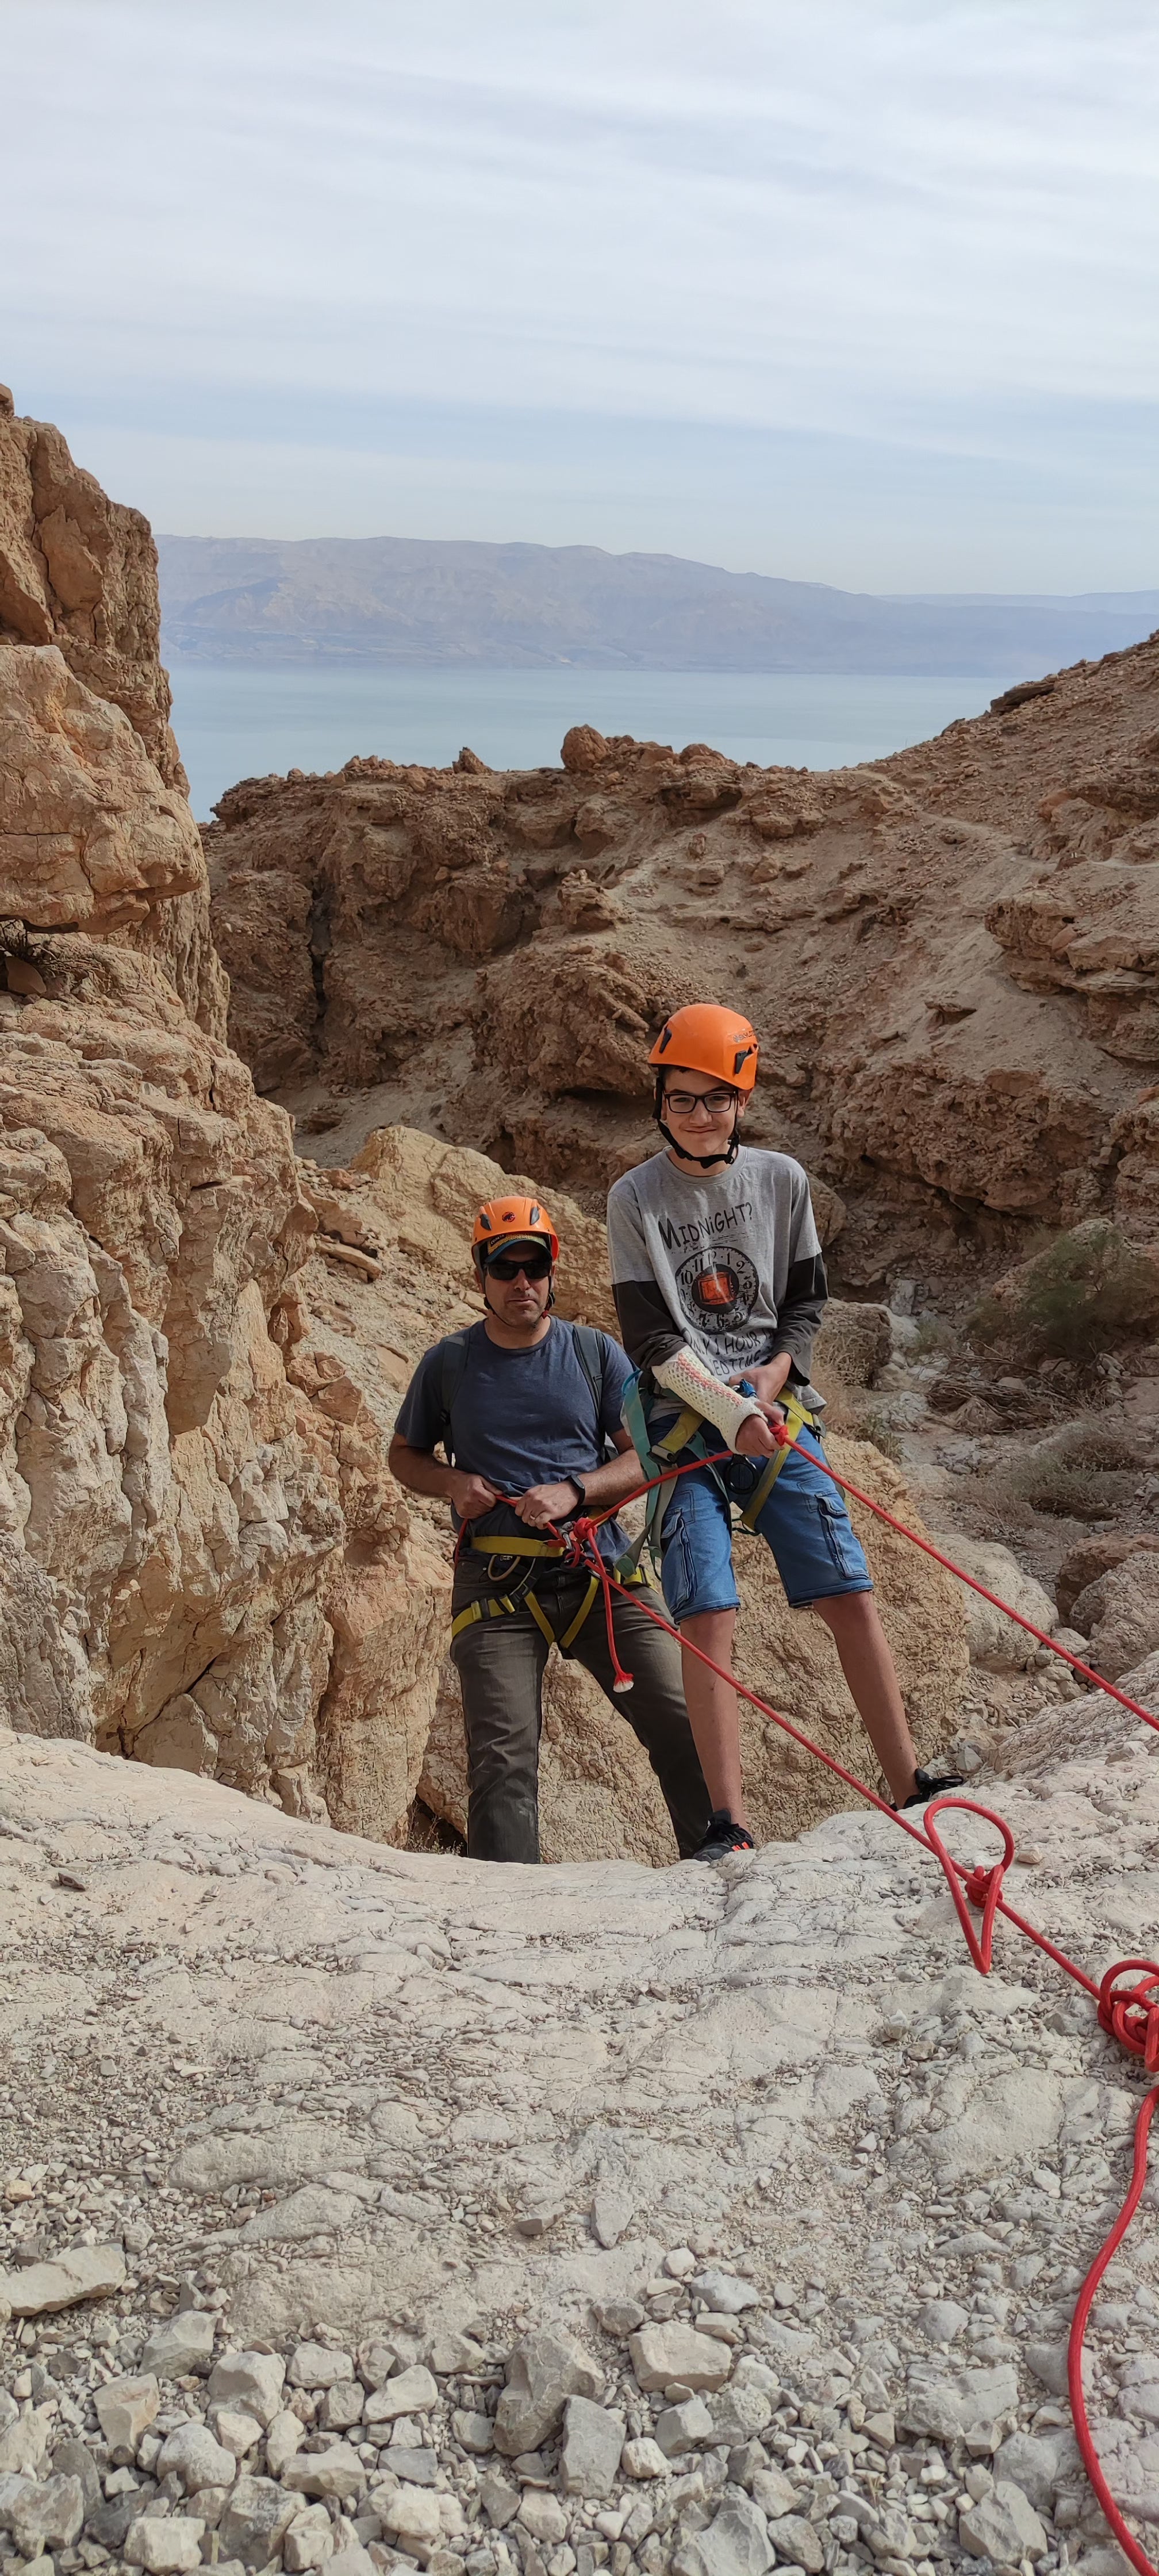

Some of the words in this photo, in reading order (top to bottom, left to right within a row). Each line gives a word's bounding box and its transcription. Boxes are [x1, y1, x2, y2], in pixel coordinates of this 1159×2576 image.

[694, 1258, 703, 1272] 11
[727, 1252, 730, 1265] 1
[736, 1260, 746, 1274] 2
[681, 1270, 693, 1285] 10
[725, 1331, 761, 1355] HOUR
[711, 1350, 761, 1376] EDTIME
